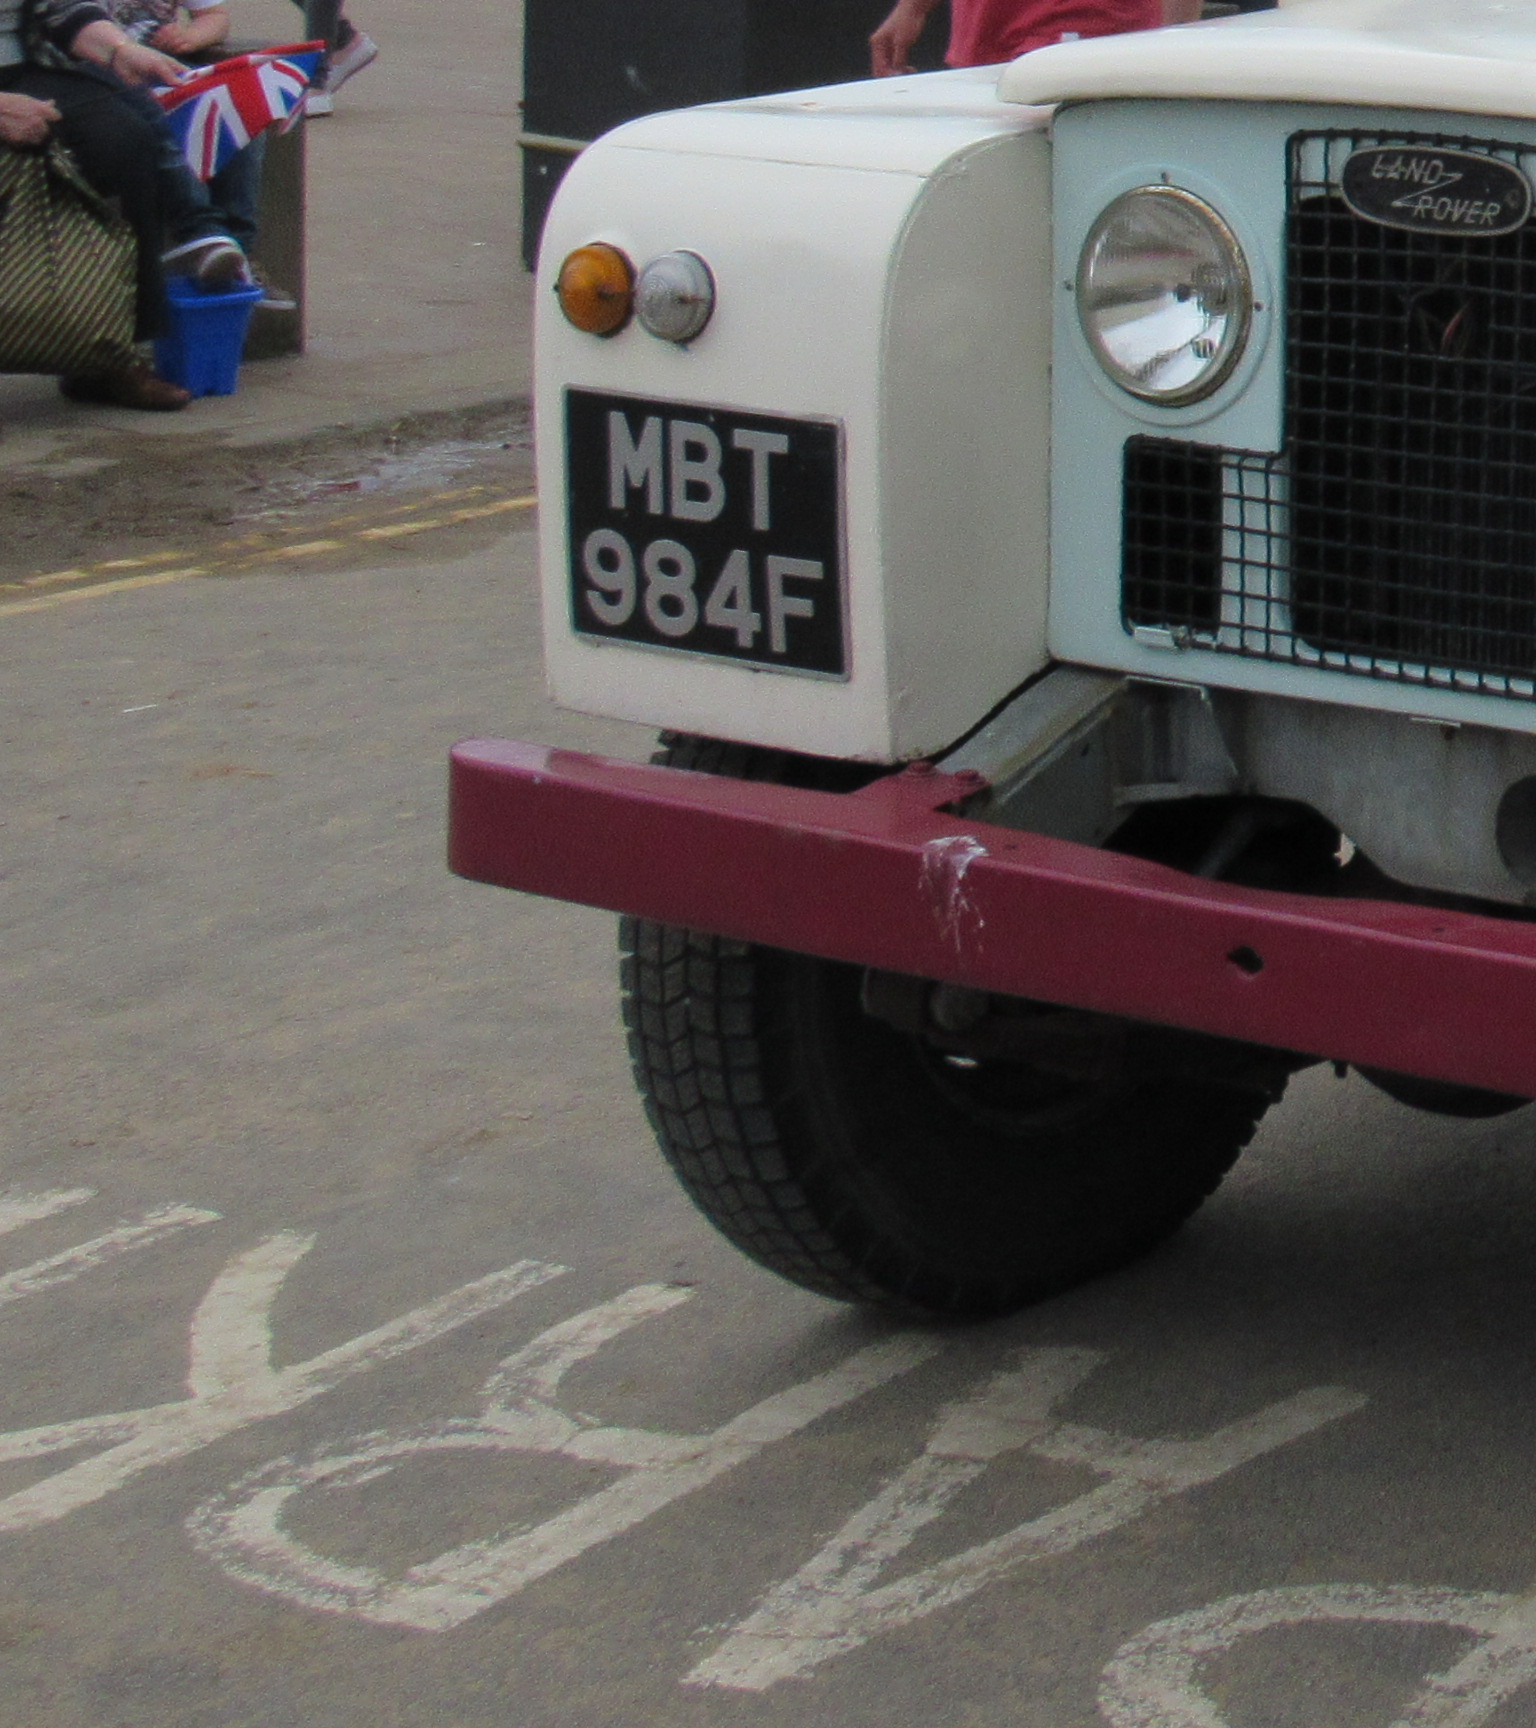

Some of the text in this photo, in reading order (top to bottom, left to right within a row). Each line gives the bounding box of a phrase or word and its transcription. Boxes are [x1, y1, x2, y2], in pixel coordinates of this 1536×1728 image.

[1371, 153, 1444, 185] LAND
[1413, 194, 1501, 226] ROVER
[608, 410, 790, 532] MBT
[582, 528, 824, 653] 984F
